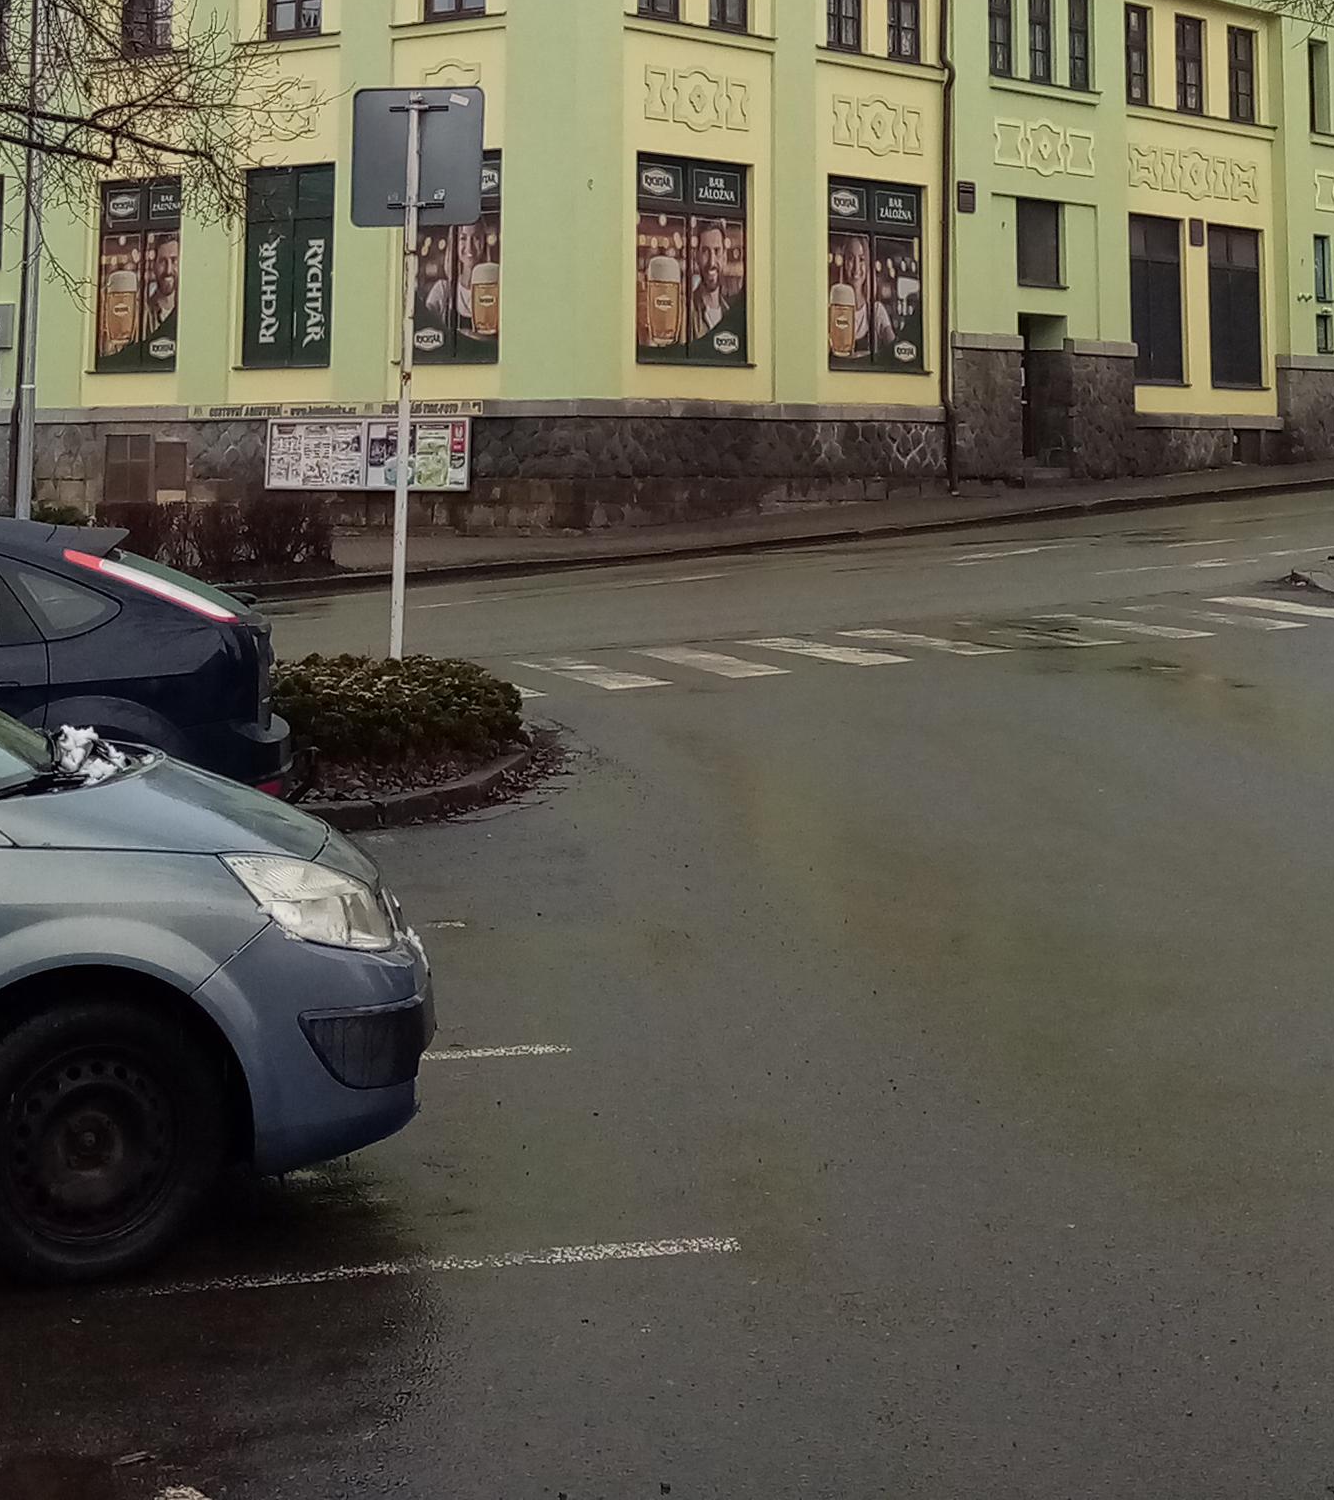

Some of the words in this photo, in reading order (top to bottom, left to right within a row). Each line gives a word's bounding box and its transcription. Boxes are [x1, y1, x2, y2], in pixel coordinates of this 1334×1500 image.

[698, 187, 736, 202] ZÁLOŽNA
[708, 177, 725, 188] BAR
[258, 234, 285, 344] RYCHTÁŘ
[302, 238, 325, 348] RYCHTÁŘ
